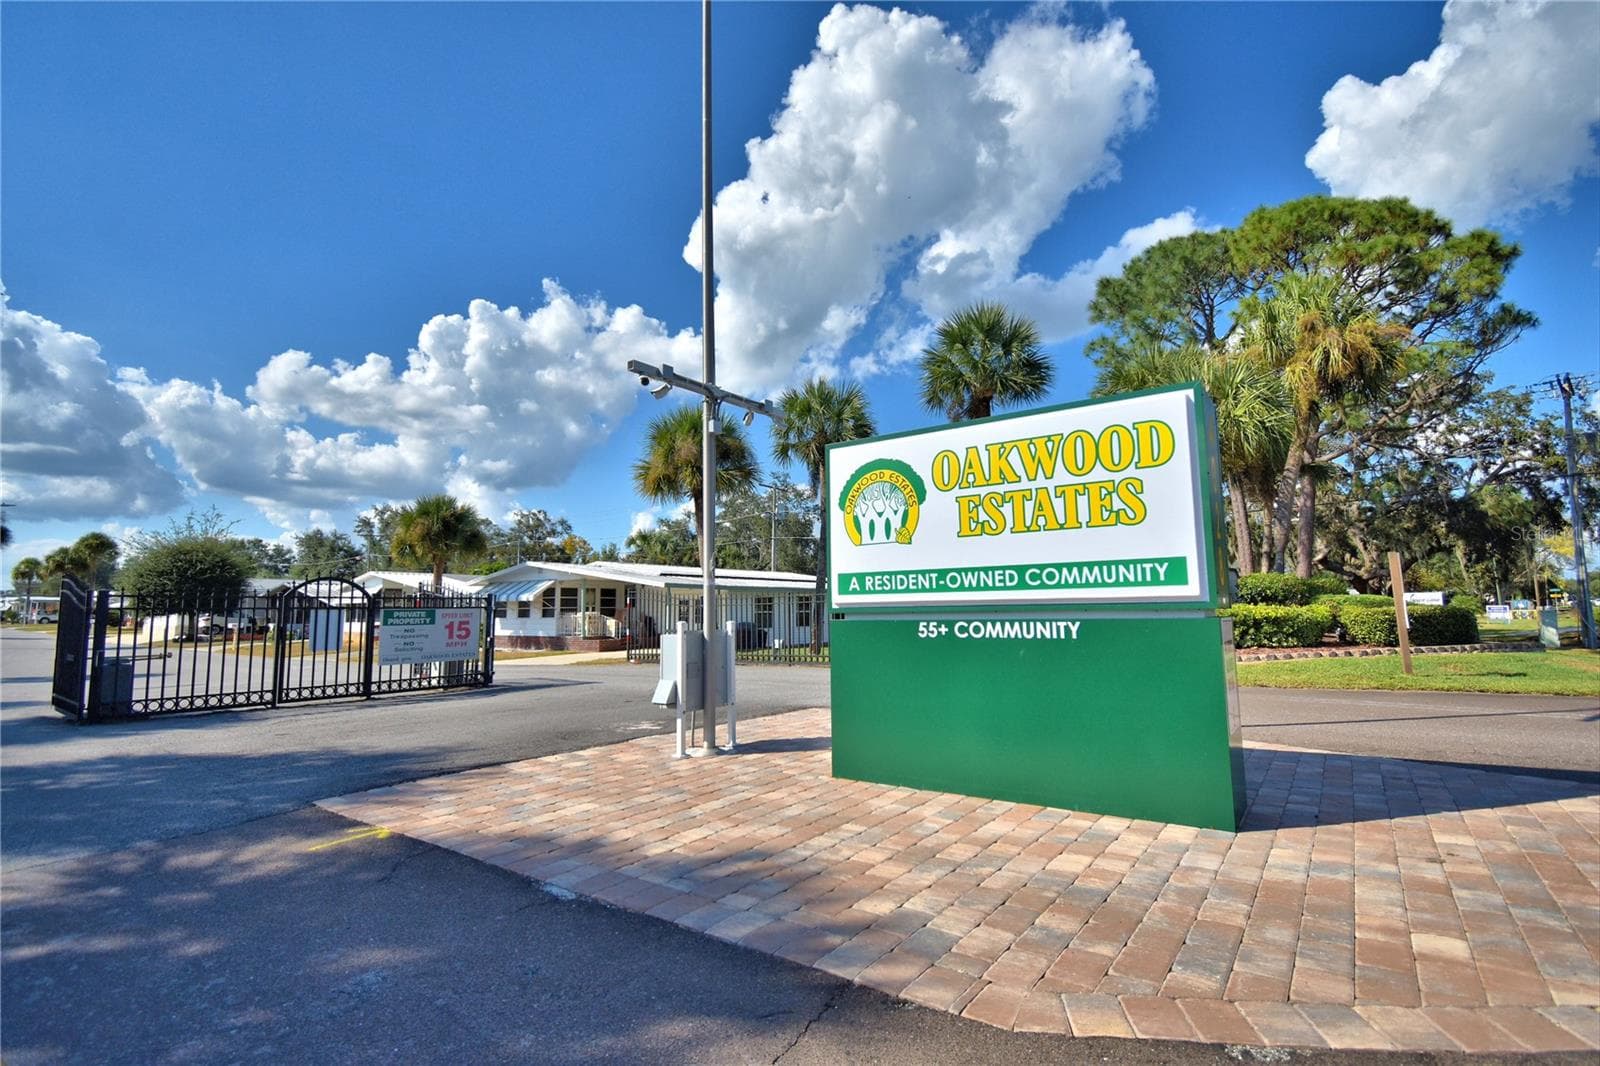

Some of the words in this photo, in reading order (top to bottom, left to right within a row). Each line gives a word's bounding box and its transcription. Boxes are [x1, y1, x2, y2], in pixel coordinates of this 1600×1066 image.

[931, 419, 1176, 493] OAKWOOD
[846, 471, 885, 515] OAKWOOD
[888, 473, 917, 508] ESTATES
[955, 477, 1147, 538] ESTATES
[848, 575, 863, 591] A
[865, 570, 1019, 592] RESIDENT-OWNED
[1025, 562, 1169, 586] COMMUNITY
[387, 617, 432, 625] PROPERTY
[444, 620, 472, 640] 15
[917, 621, 949, 640] 55+
[954, 621, 1081, 640] COMMUNITY
